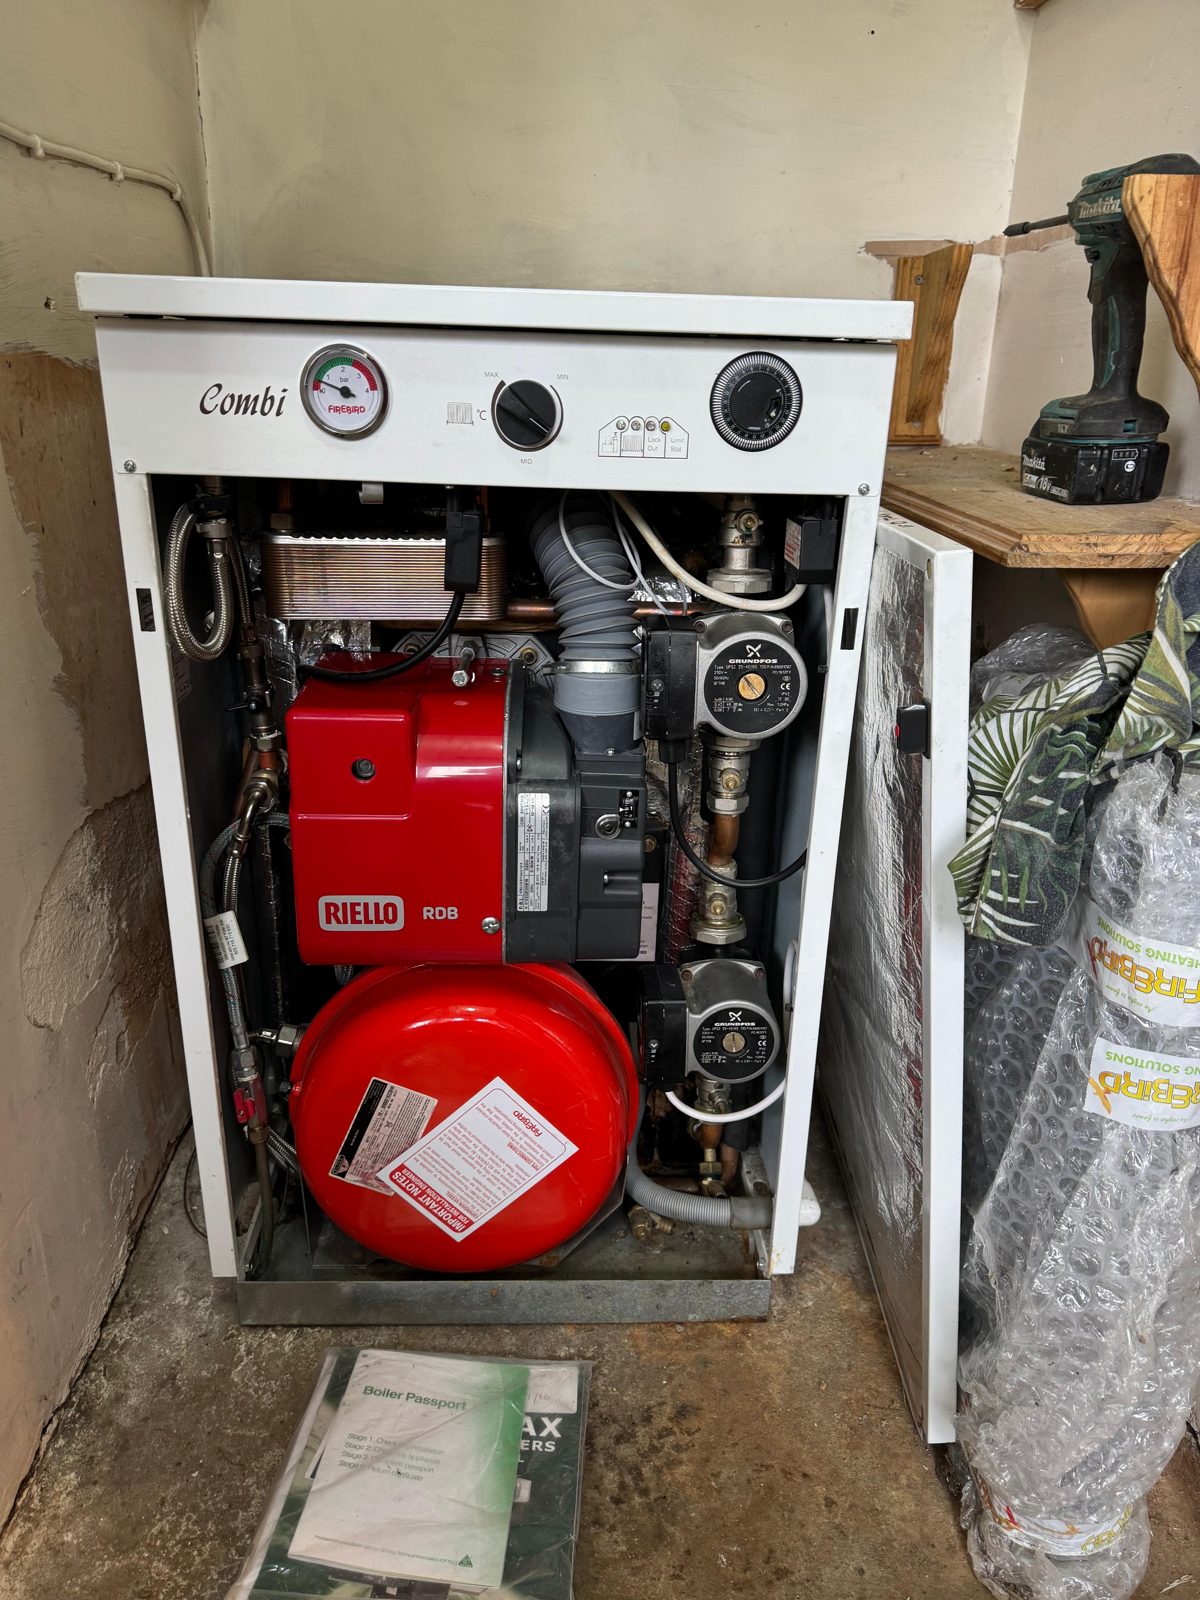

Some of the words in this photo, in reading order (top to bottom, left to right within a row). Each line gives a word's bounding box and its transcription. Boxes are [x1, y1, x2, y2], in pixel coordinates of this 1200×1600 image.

[199, 382, 289, 417] Combi
[328, 405, 366, 414] FIREBIRD
[324, 901, 399, 925] RIELLO
[422, 906, 459, 920] RDB
[1098, 916, 1142, 953] SOLUTIONS
[1105, 1051, 1180, 1074] SOLUTIONS
[511, 1109, 543, 1136] FIREBIRD
[392, 1171, 421, 1196] NOTES
[402, 1168, 427, 1190] ENGINEER
[417, 1193, 466, 1232] IMPORTANT
[425, 1187, 460, 1216] INSTALLATION
[457, 1214, 469, 1224] FOR
[362, 1385, 404, 1400] Boiler
[405, 1392, 467, 1410] Passport
[344, 1442, 364, 1451] Stage
[348, 1432, 368, 1442] Stage
[338, 1460, 359, 1469] Stage
[341, 1450, 362, 1460] Stage
